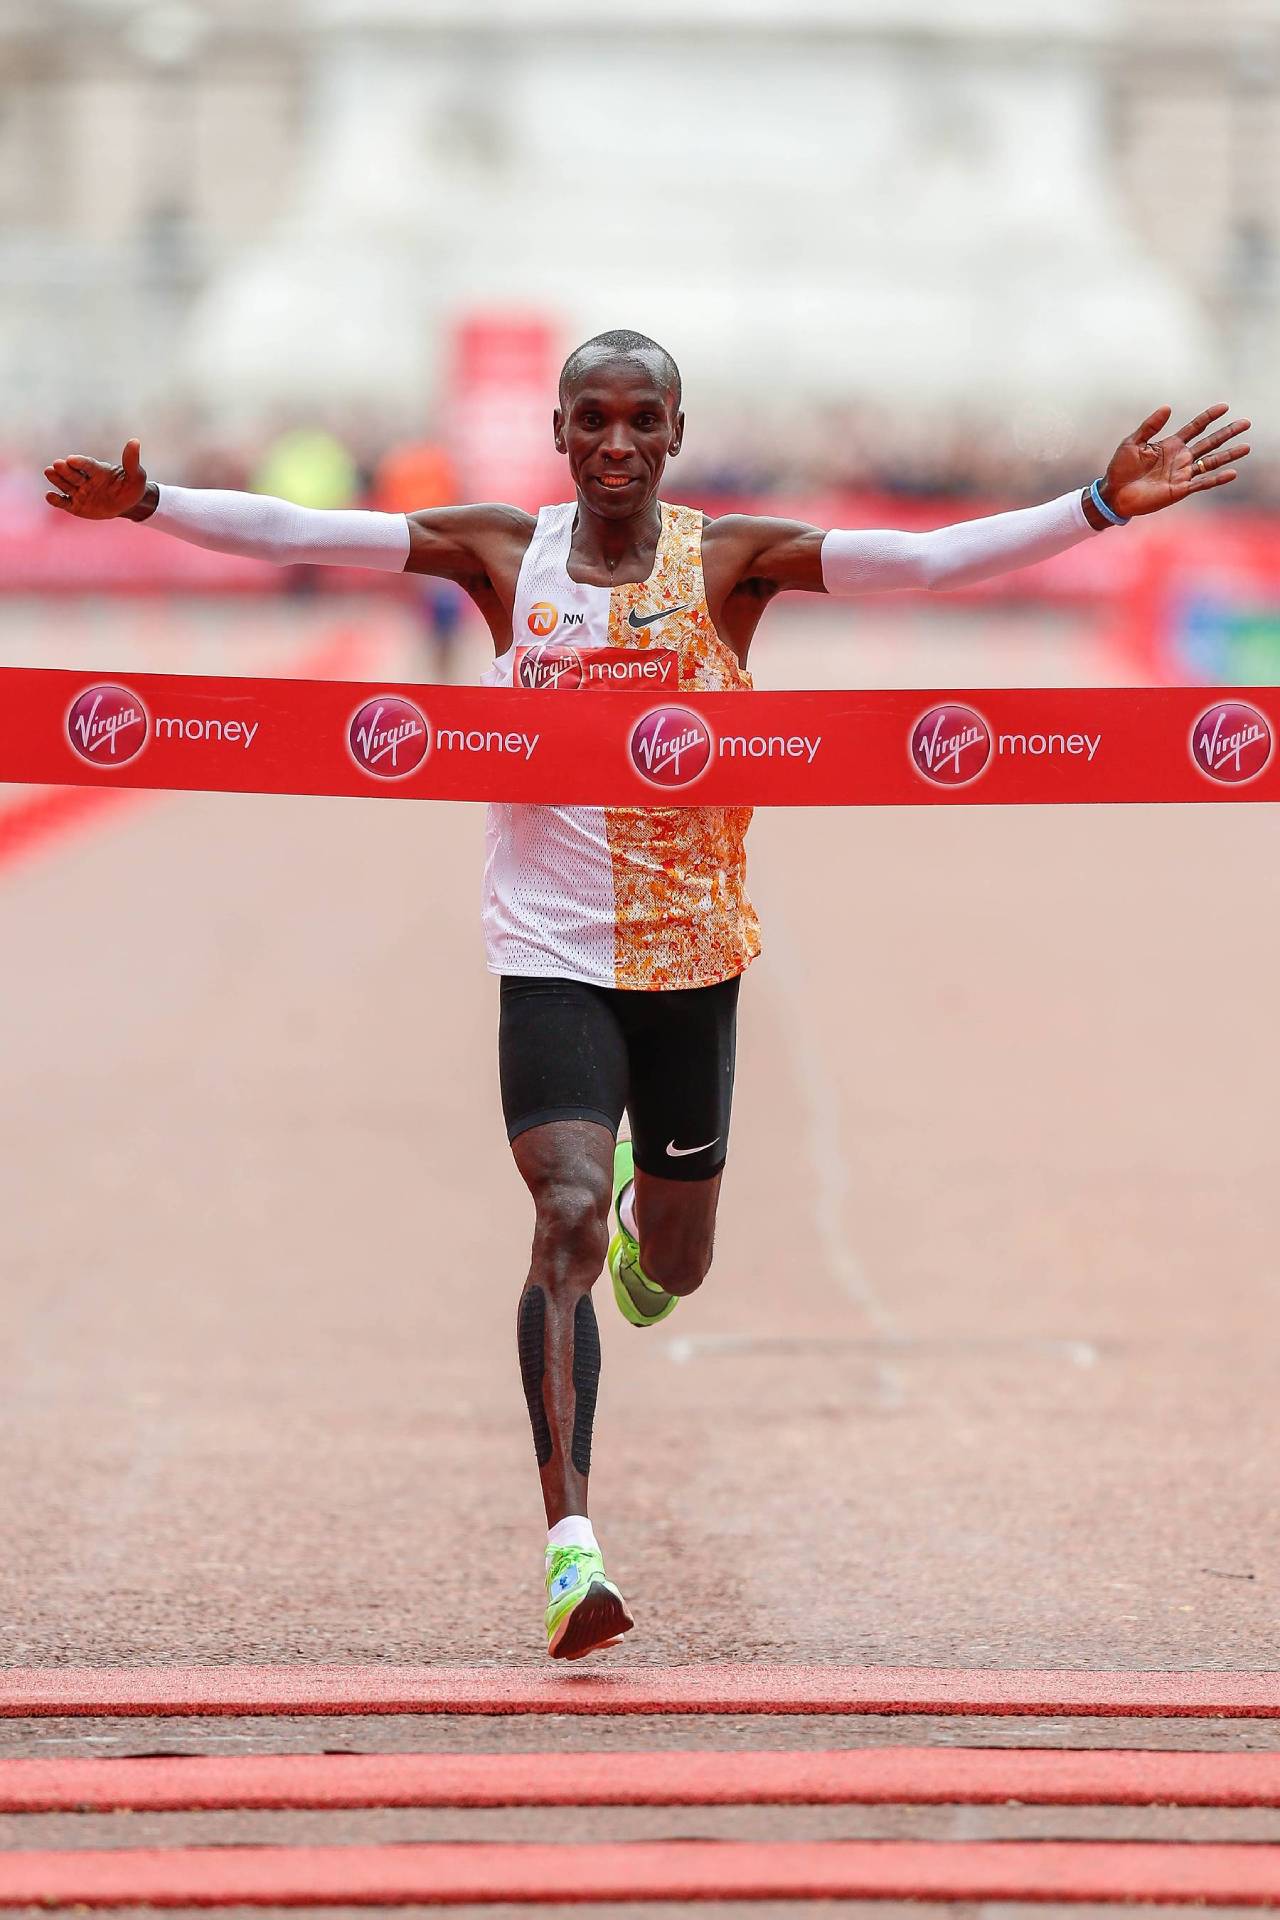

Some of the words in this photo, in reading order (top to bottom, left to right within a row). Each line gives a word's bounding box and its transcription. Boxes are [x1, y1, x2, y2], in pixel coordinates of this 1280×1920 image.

[563, 613, 584, 625] NN
[523, 646, 580, 689] Virgin
[589, 661, 671, 683] money
[75, 695, 141, 754] Virgin
[155, 716, 259, 748] money
[357, 707, 423, 766] Virgin
[437, 729, 540, 760] money
[639, 717, 705, 775] Virgin
[719, 734, 821, 763] money
[919, 715, 985, 774] Virgin
[999, 731, 1101, 761] money
[1200, 713, 1266, 772] Virgin
